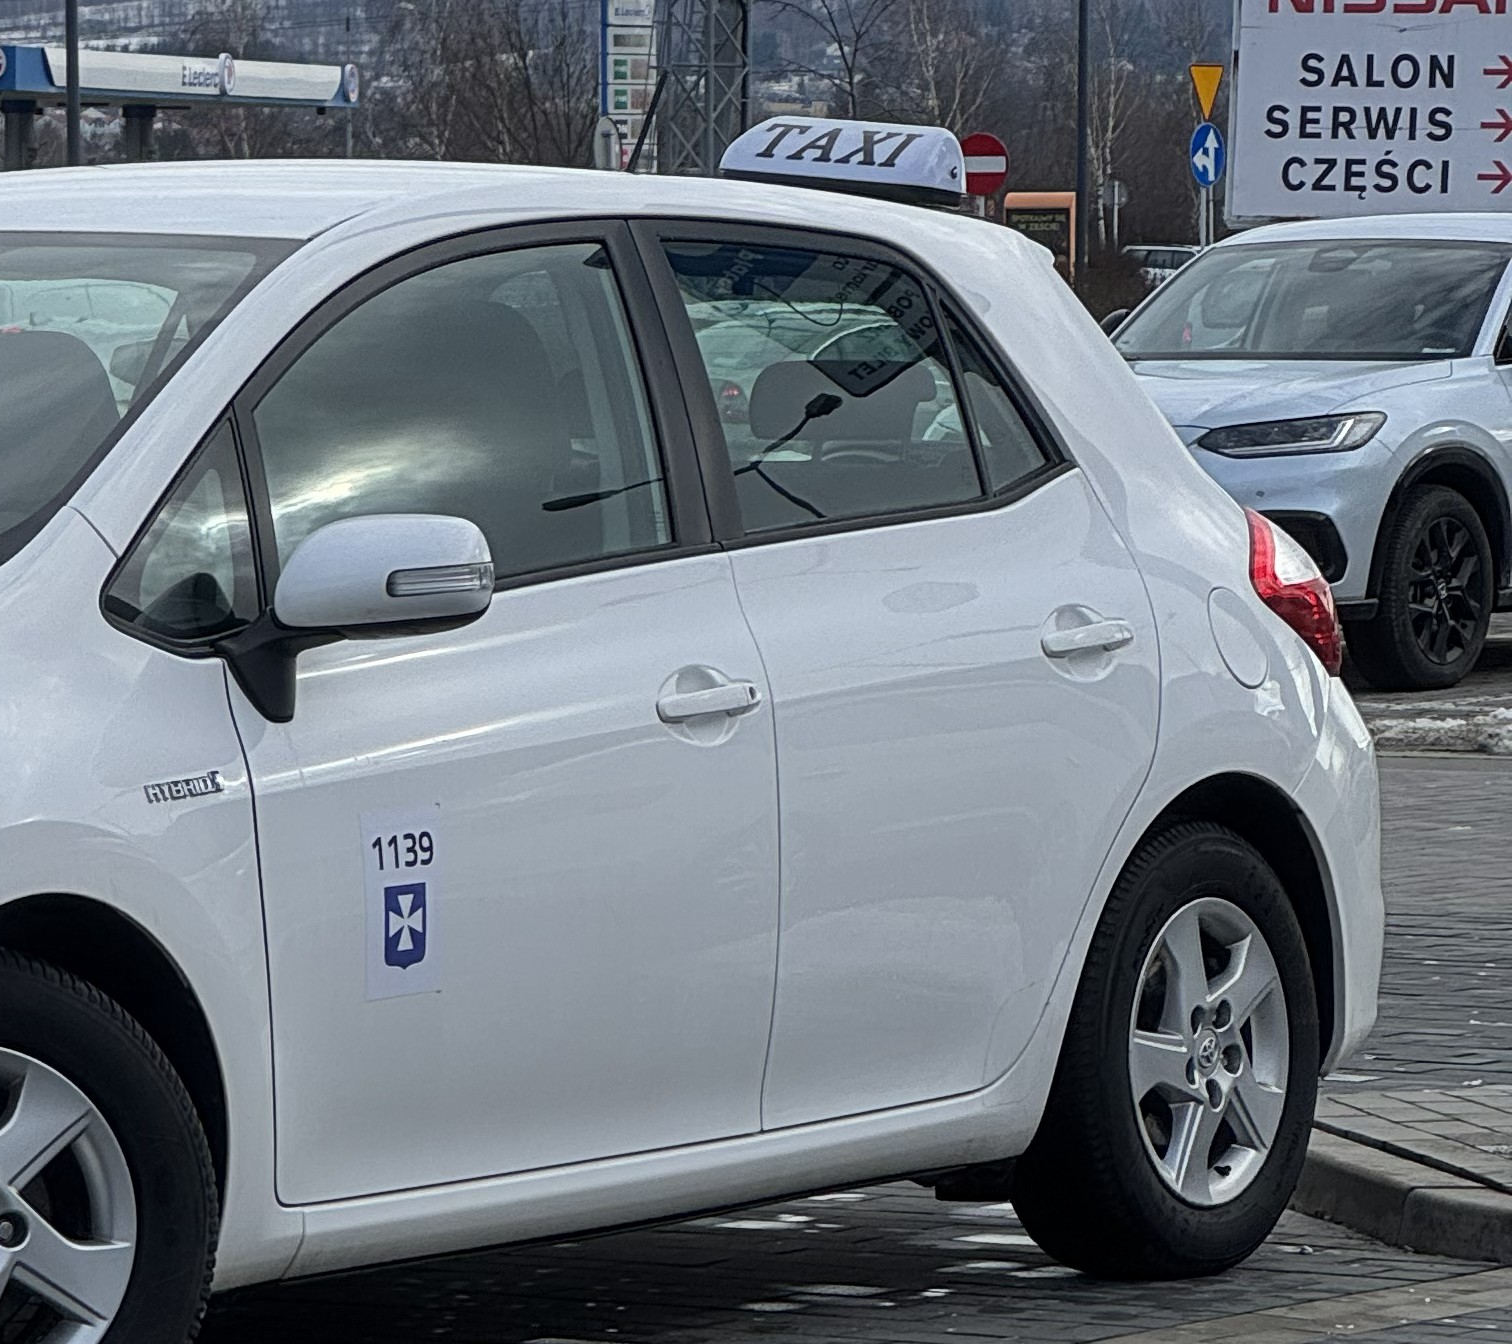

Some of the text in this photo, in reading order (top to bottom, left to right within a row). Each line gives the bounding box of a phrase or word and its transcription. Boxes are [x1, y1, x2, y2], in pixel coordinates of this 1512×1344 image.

[1299, 52, 1455, 89] SALON
[1264, 104, 1453, 142] SERWIS
[755, 123, 925, 168] TAXI
[1281, 150, 1450, 200] CZĘŚCI
[371, 831, 434, 871] 1139
